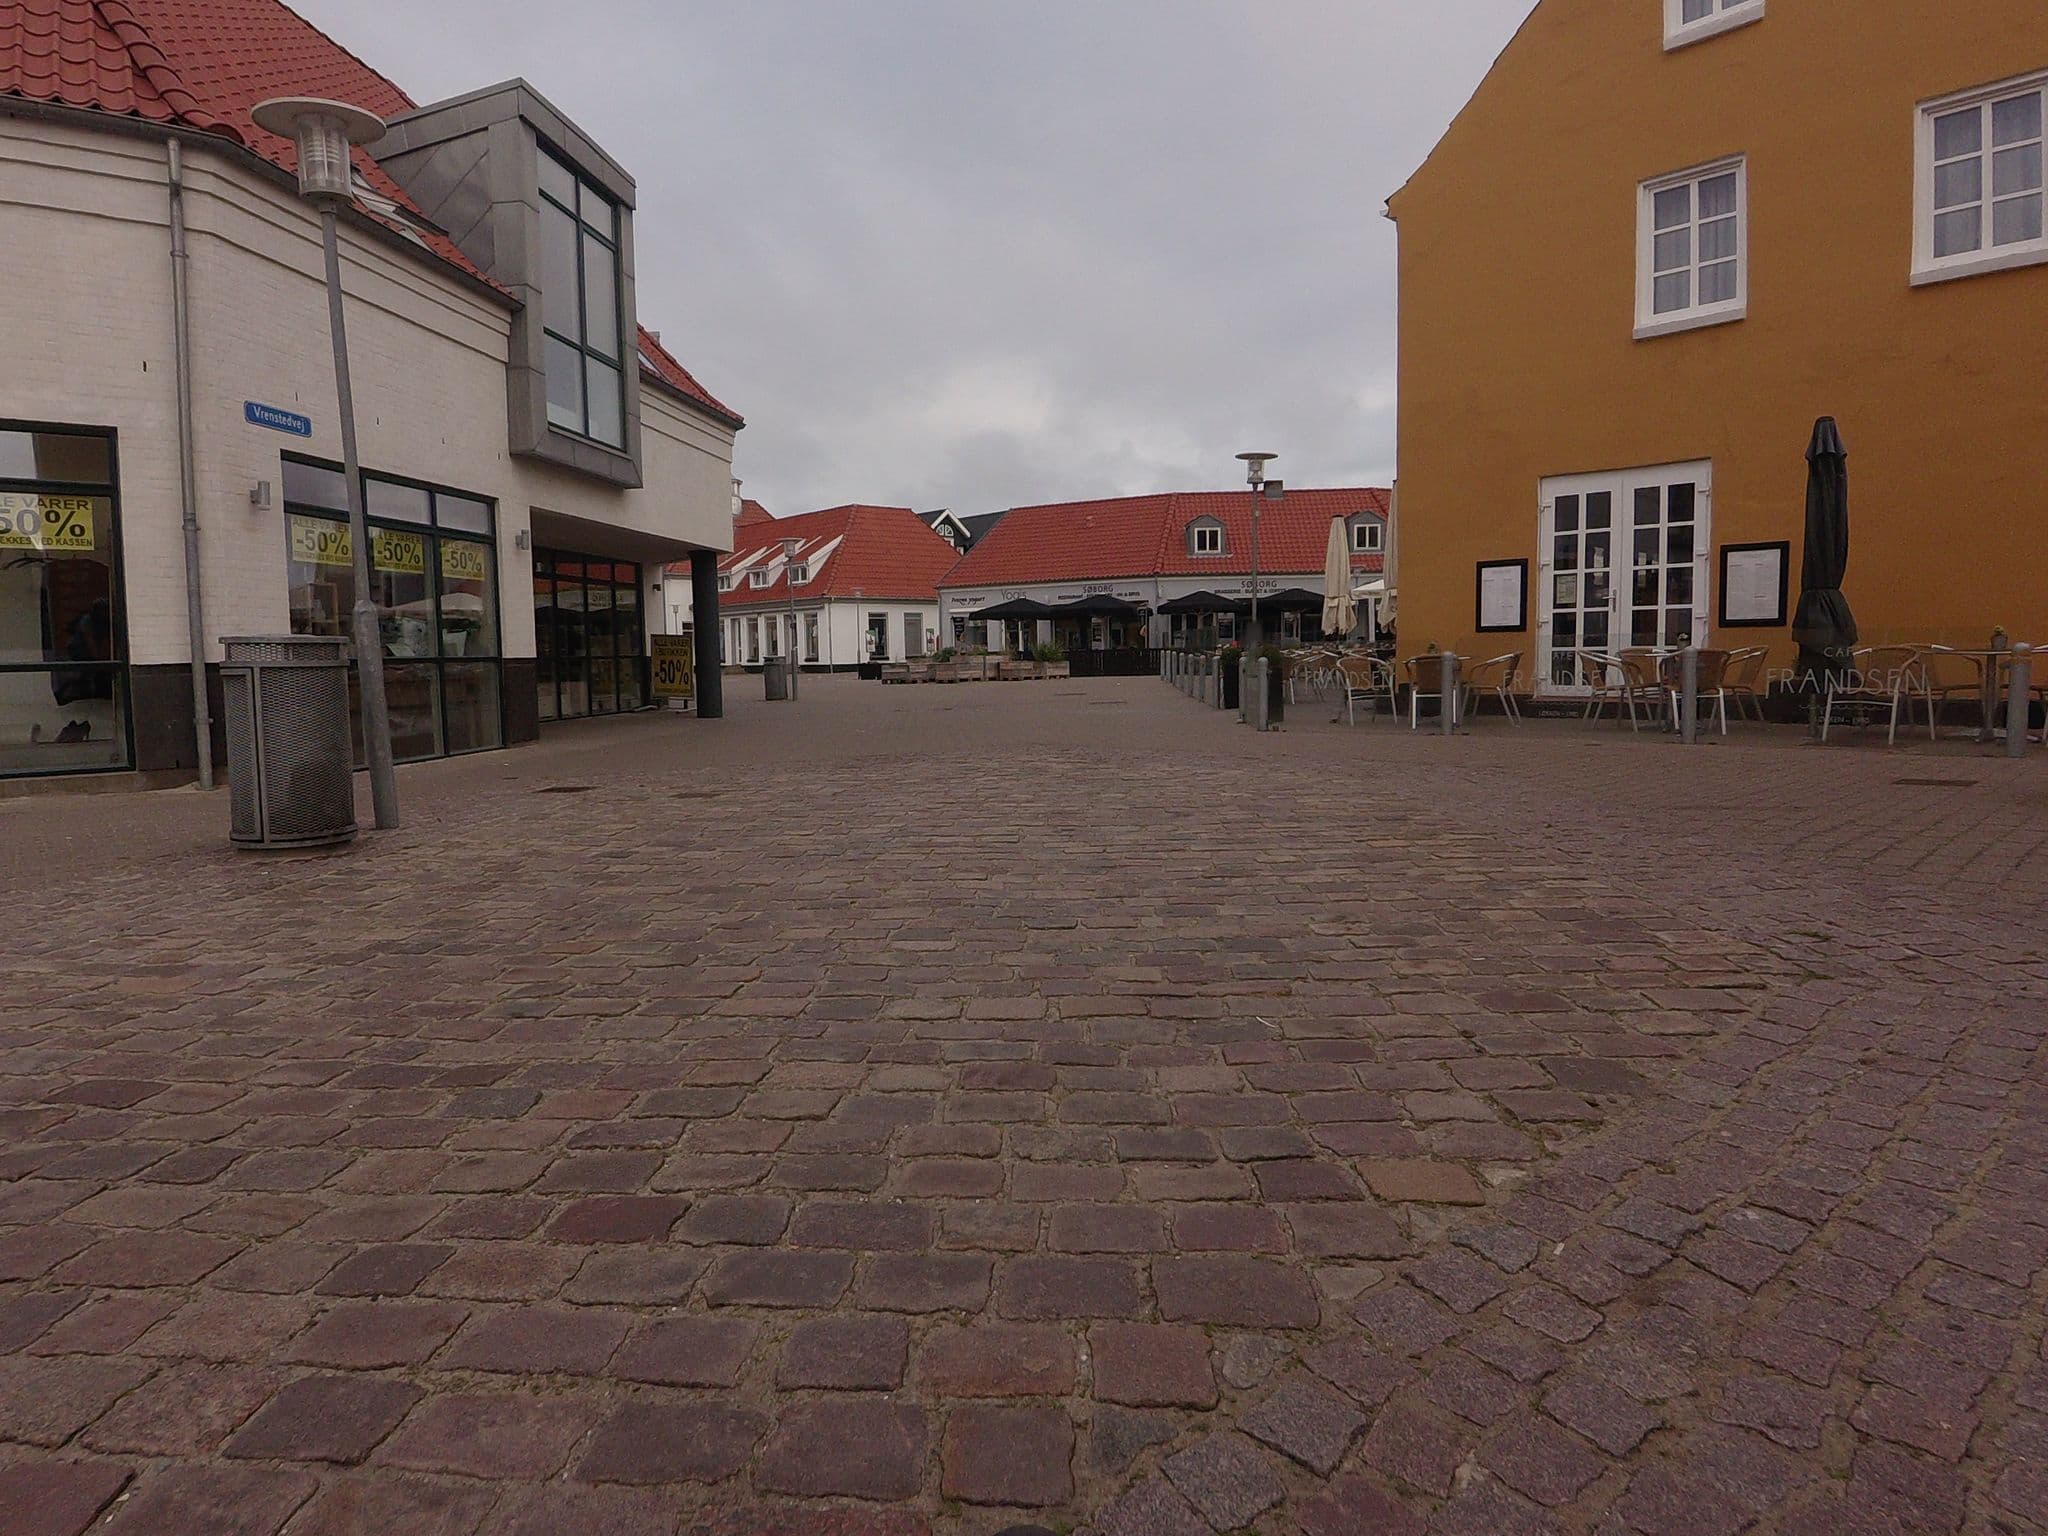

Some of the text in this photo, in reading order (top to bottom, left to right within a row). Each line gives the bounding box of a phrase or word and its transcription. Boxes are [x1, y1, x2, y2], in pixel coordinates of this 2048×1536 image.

[253, 405, 305, 433] Vrenstedvej
[55, 538, 93, 547] KASSEN
[295, 528, 349, 556] -50%
[377, 541, 421, 565] -50%
[445, 549, 483, 572] -50%
[1082, 584, 1114, 594] SØBORG
[1240, 580, 1278, 589] SØORG
[1765, 666, 1927, 699] FRANDSEN
